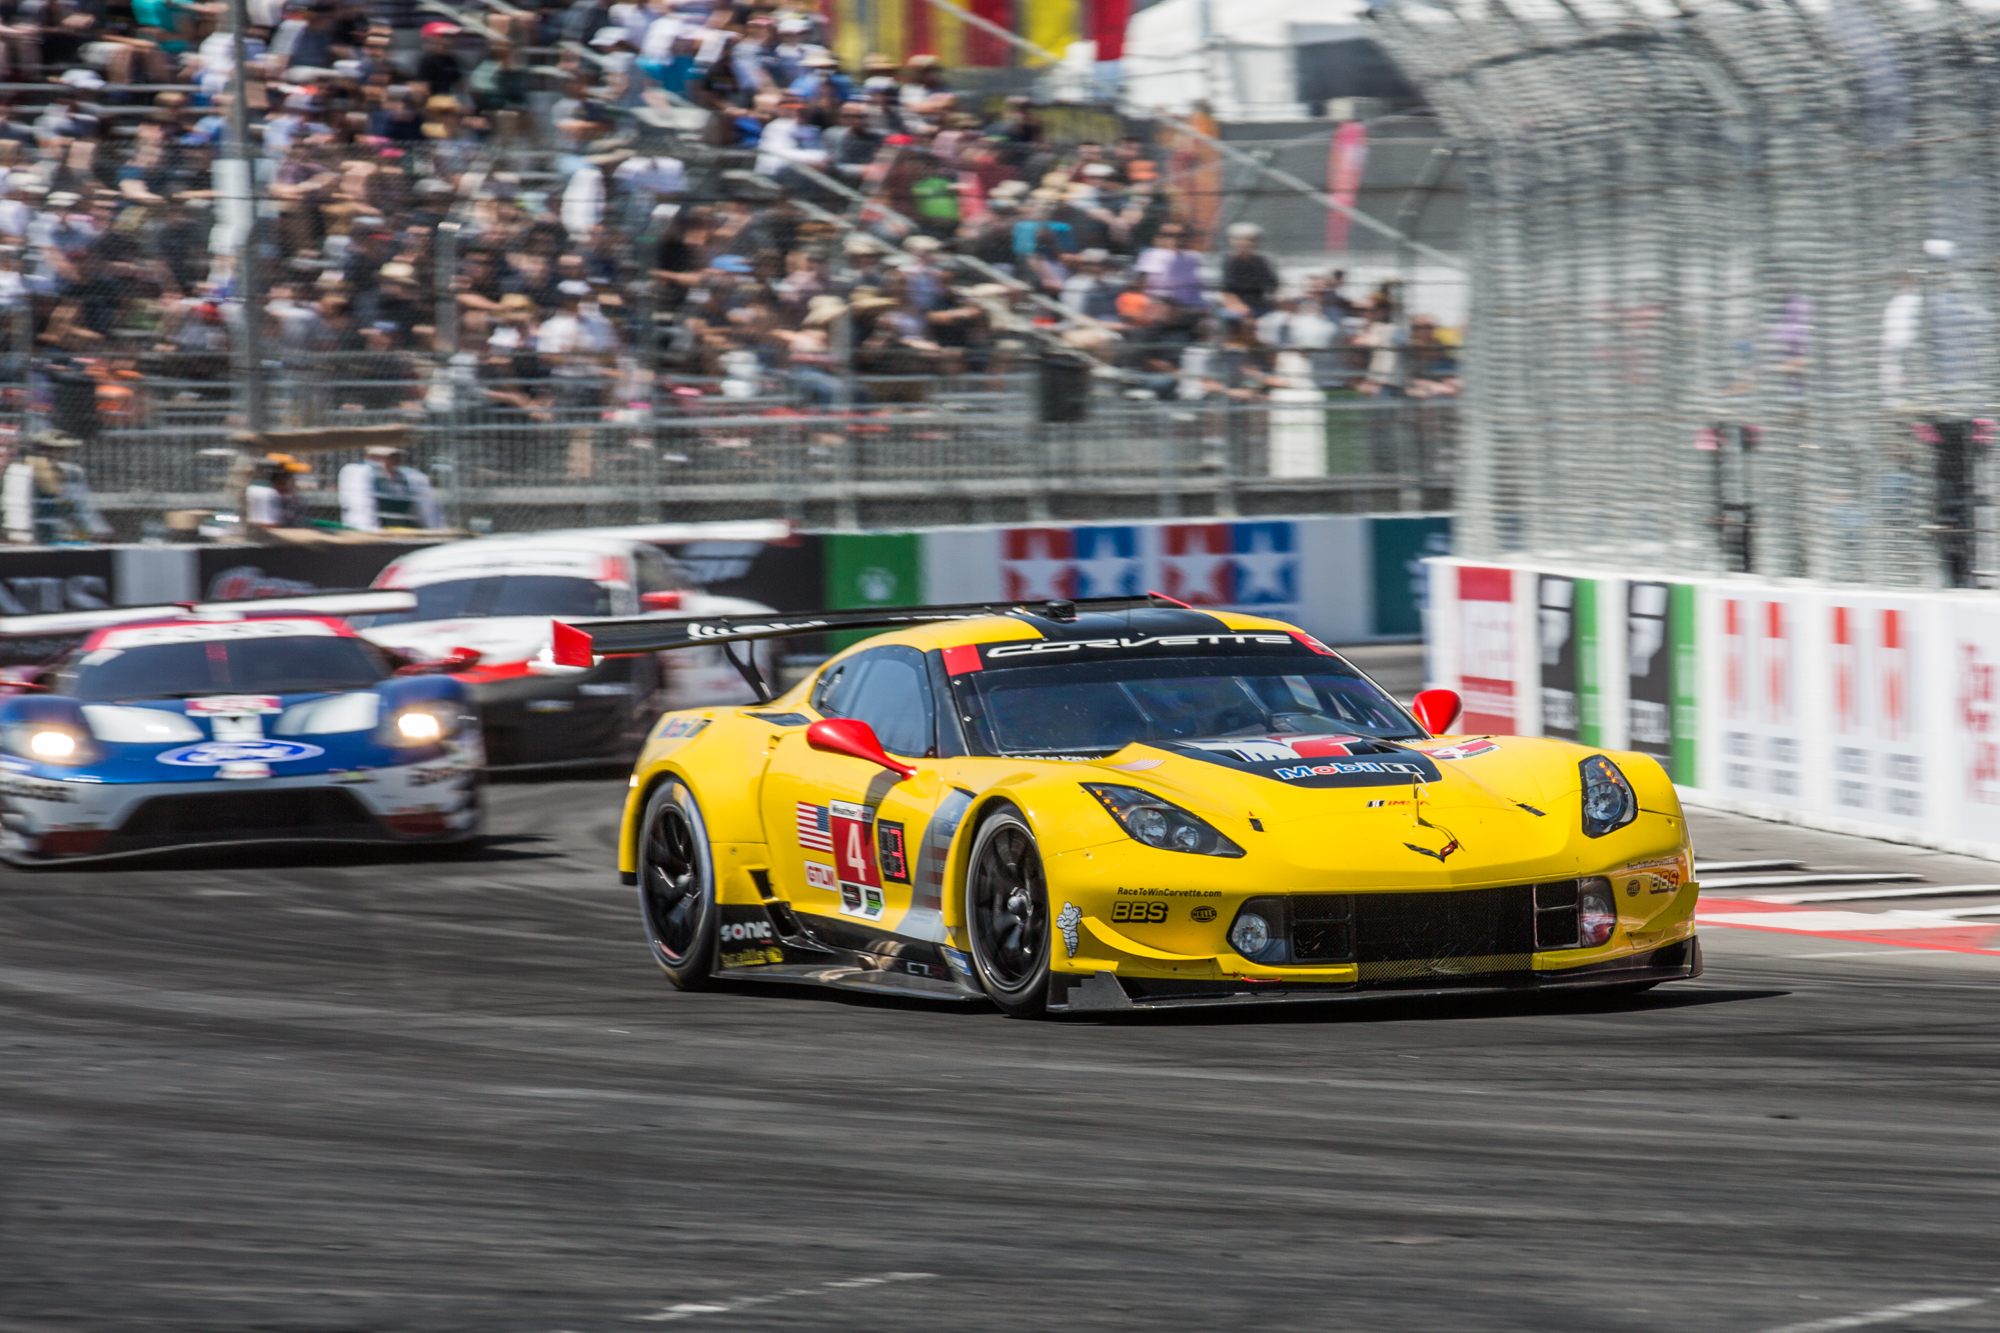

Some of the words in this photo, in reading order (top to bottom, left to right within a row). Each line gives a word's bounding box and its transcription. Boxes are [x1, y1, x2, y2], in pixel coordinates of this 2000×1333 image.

[987, 634, 1292, 657] CORVETTE
[1273, 762, 1385, 780] Mobil
[846, 822, 867, 882] 4
[1117, 887, 1222, 898] RaceToWinCorvette.com
[1649, 869, 1680, 894] BBS
[1111, 901, 1169, 923] BBS
[1192, 910, 1217, 918] HELLA
